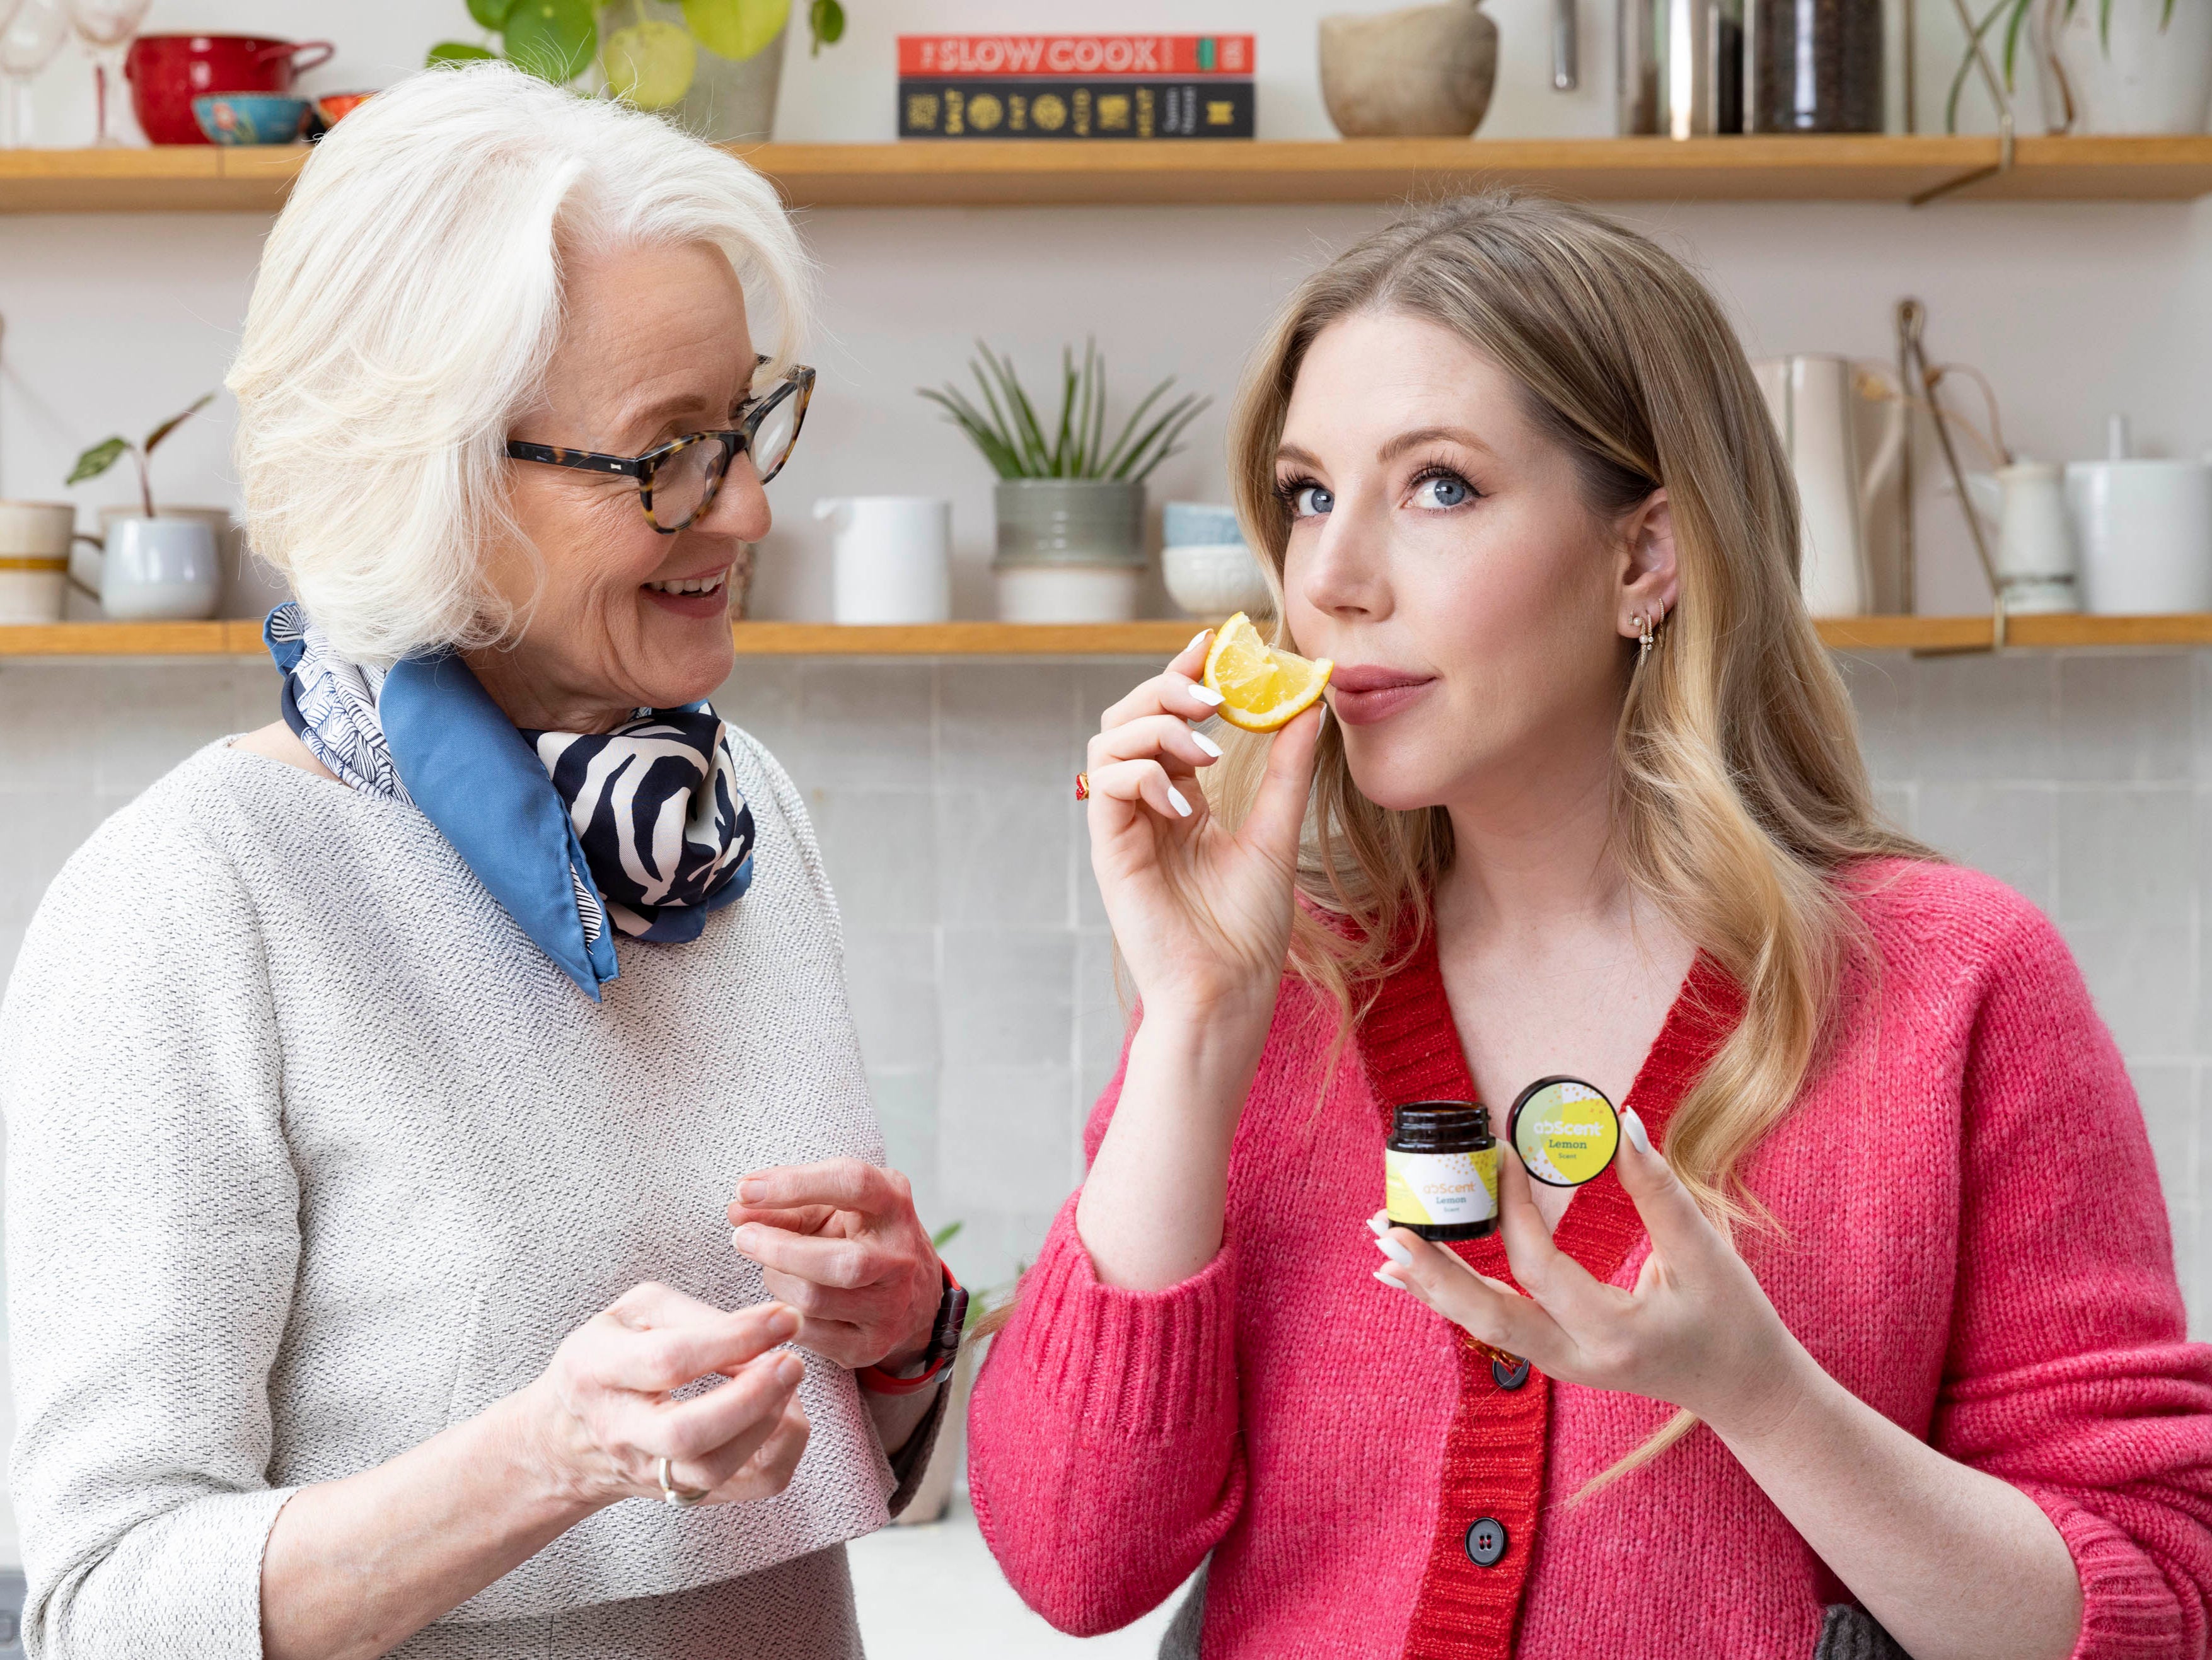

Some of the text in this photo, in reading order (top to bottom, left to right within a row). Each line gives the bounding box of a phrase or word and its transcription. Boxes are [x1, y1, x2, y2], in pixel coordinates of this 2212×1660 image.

[938, 38, 1045, 72] SLOW
[1048, 38, 1157, 72] COOK
[1549, 1139, 1587, 1149] Lemon
[1436, 1196, 1467, 1204] Lemon
